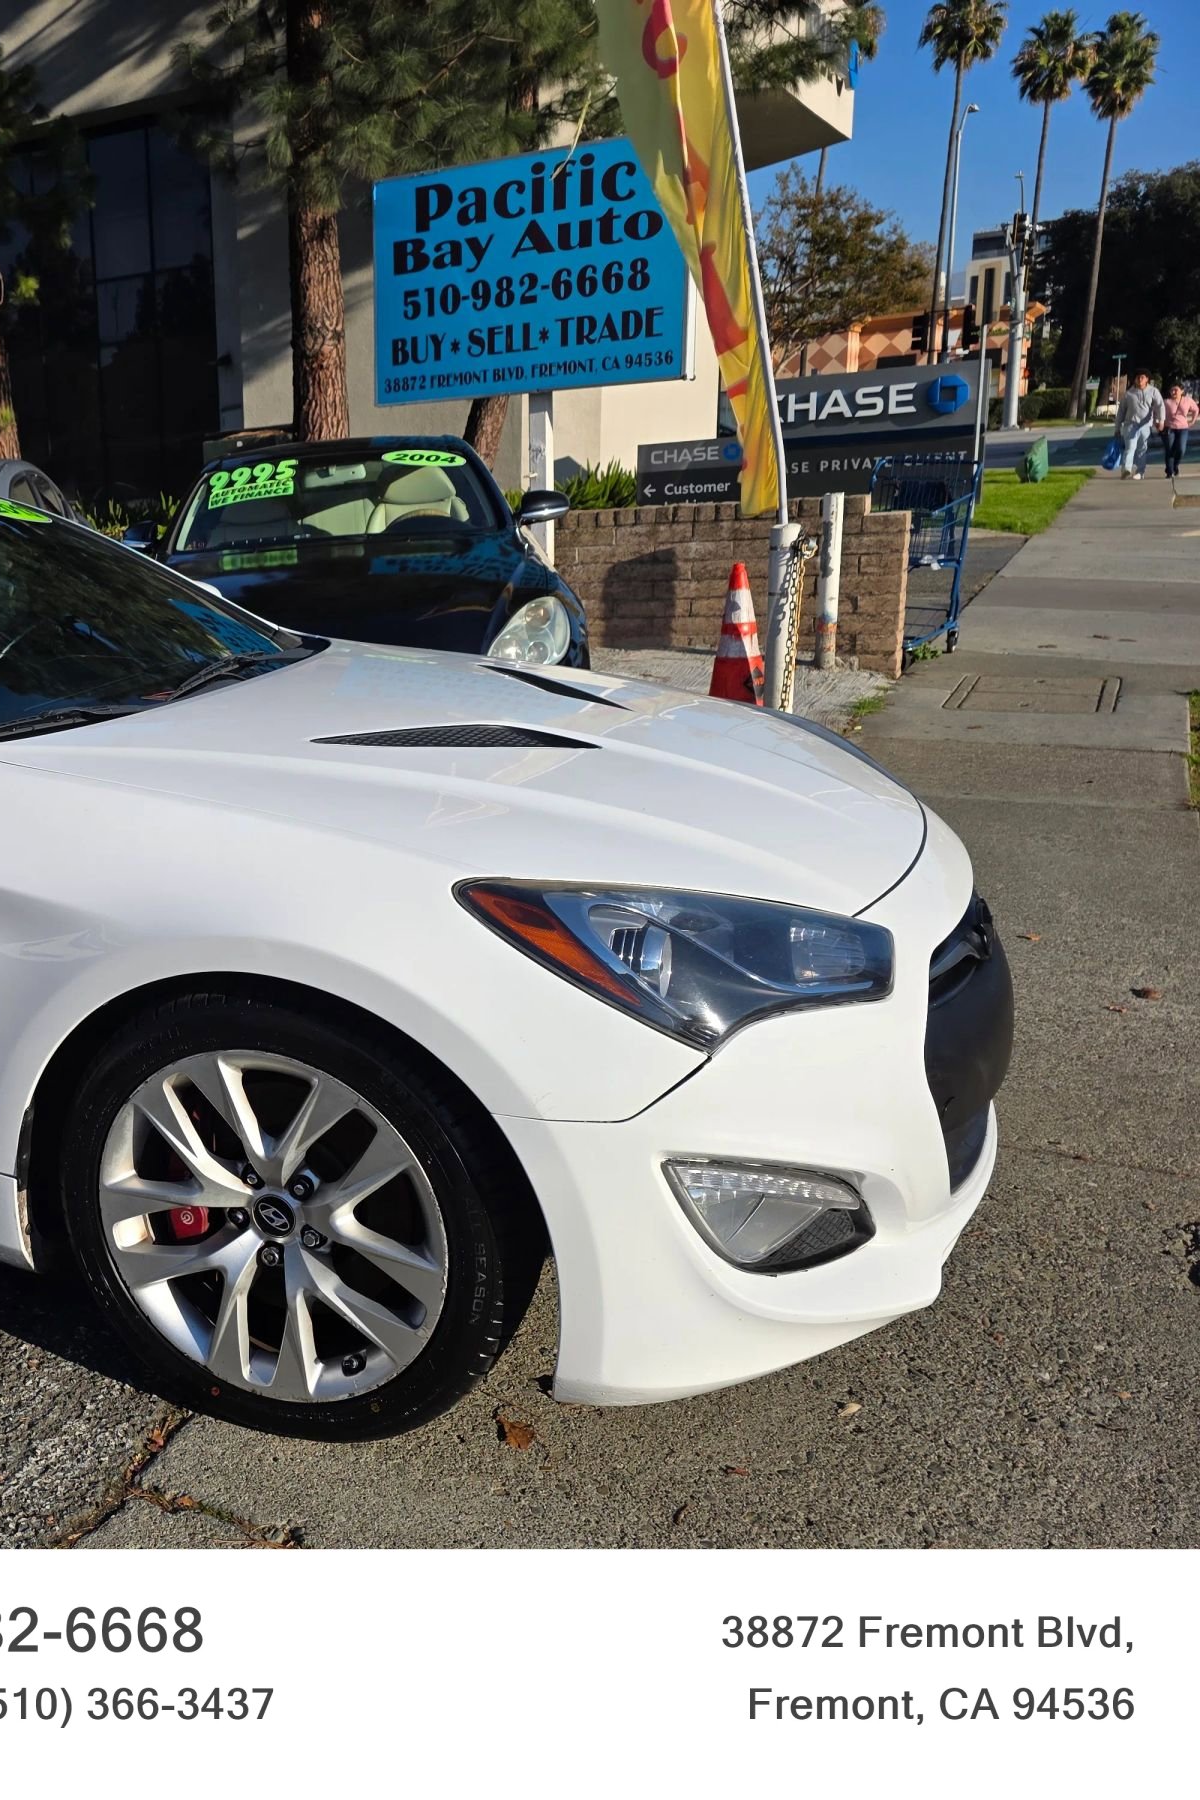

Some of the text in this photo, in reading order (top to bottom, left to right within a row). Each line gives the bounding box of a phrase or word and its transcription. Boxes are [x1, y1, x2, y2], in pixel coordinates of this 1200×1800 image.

[415, 153, 636, 233] Pacific
[393, 207, 663, 277] Bay Auto
[403, 257, 651, 321] 510-982-6668
[391, 306, 664, 367] BUY SELL TRADE
[384, 374, 426, 394] 38872
[430, 369, 489, 389] FREMONT
[601, 356, 620, 371] CA
[624, 349, 674, 369] 94536
[390, 452, 458, 464] 2004
[650, 446, 720, 464] CHASE
[209, 459, 299, 492] 9995
[212, 480, 290, 500] AUTOMATIC
[664, 481, 731, 495] Customer
[210, 486, 291, 506] WE FINANCE
